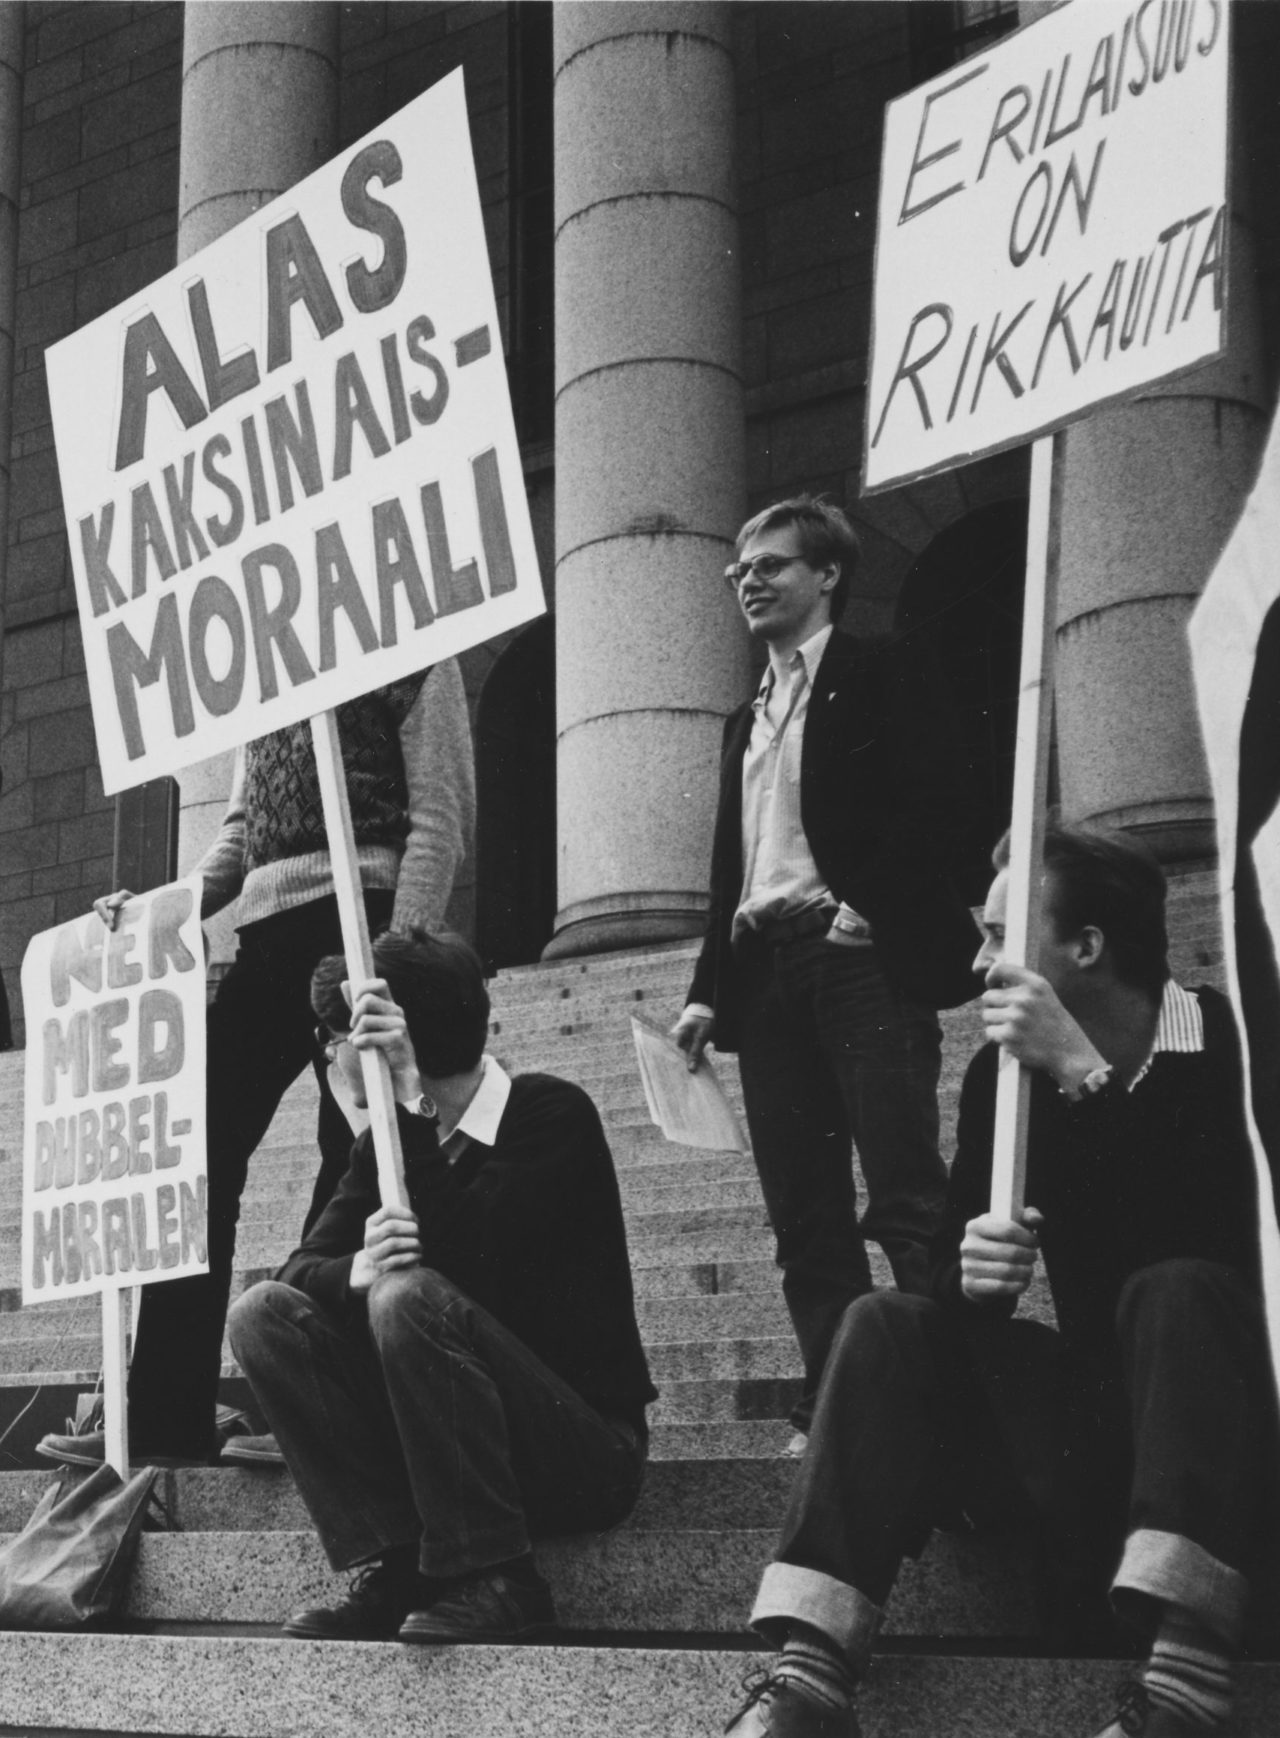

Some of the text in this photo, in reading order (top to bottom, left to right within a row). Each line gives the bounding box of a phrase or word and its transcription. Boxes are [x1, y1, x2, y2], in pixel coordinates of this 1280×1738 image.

[1009, 137, 1106, 268] ON
[115, 138, 408, 472] ALAS
[872, 203, 1226, 449] RIKKAUTTA
[77, 314, 492, 619] KAKSINAIS-
[105, 446, 518, 761] MORAALI
[50, 888, 196, 1008] NER
[42, 989, 186, 1106] MED
[33, 1091, 193, 1192] DUBBEL-
[31, 1174, 208, 1290] MORALEN
